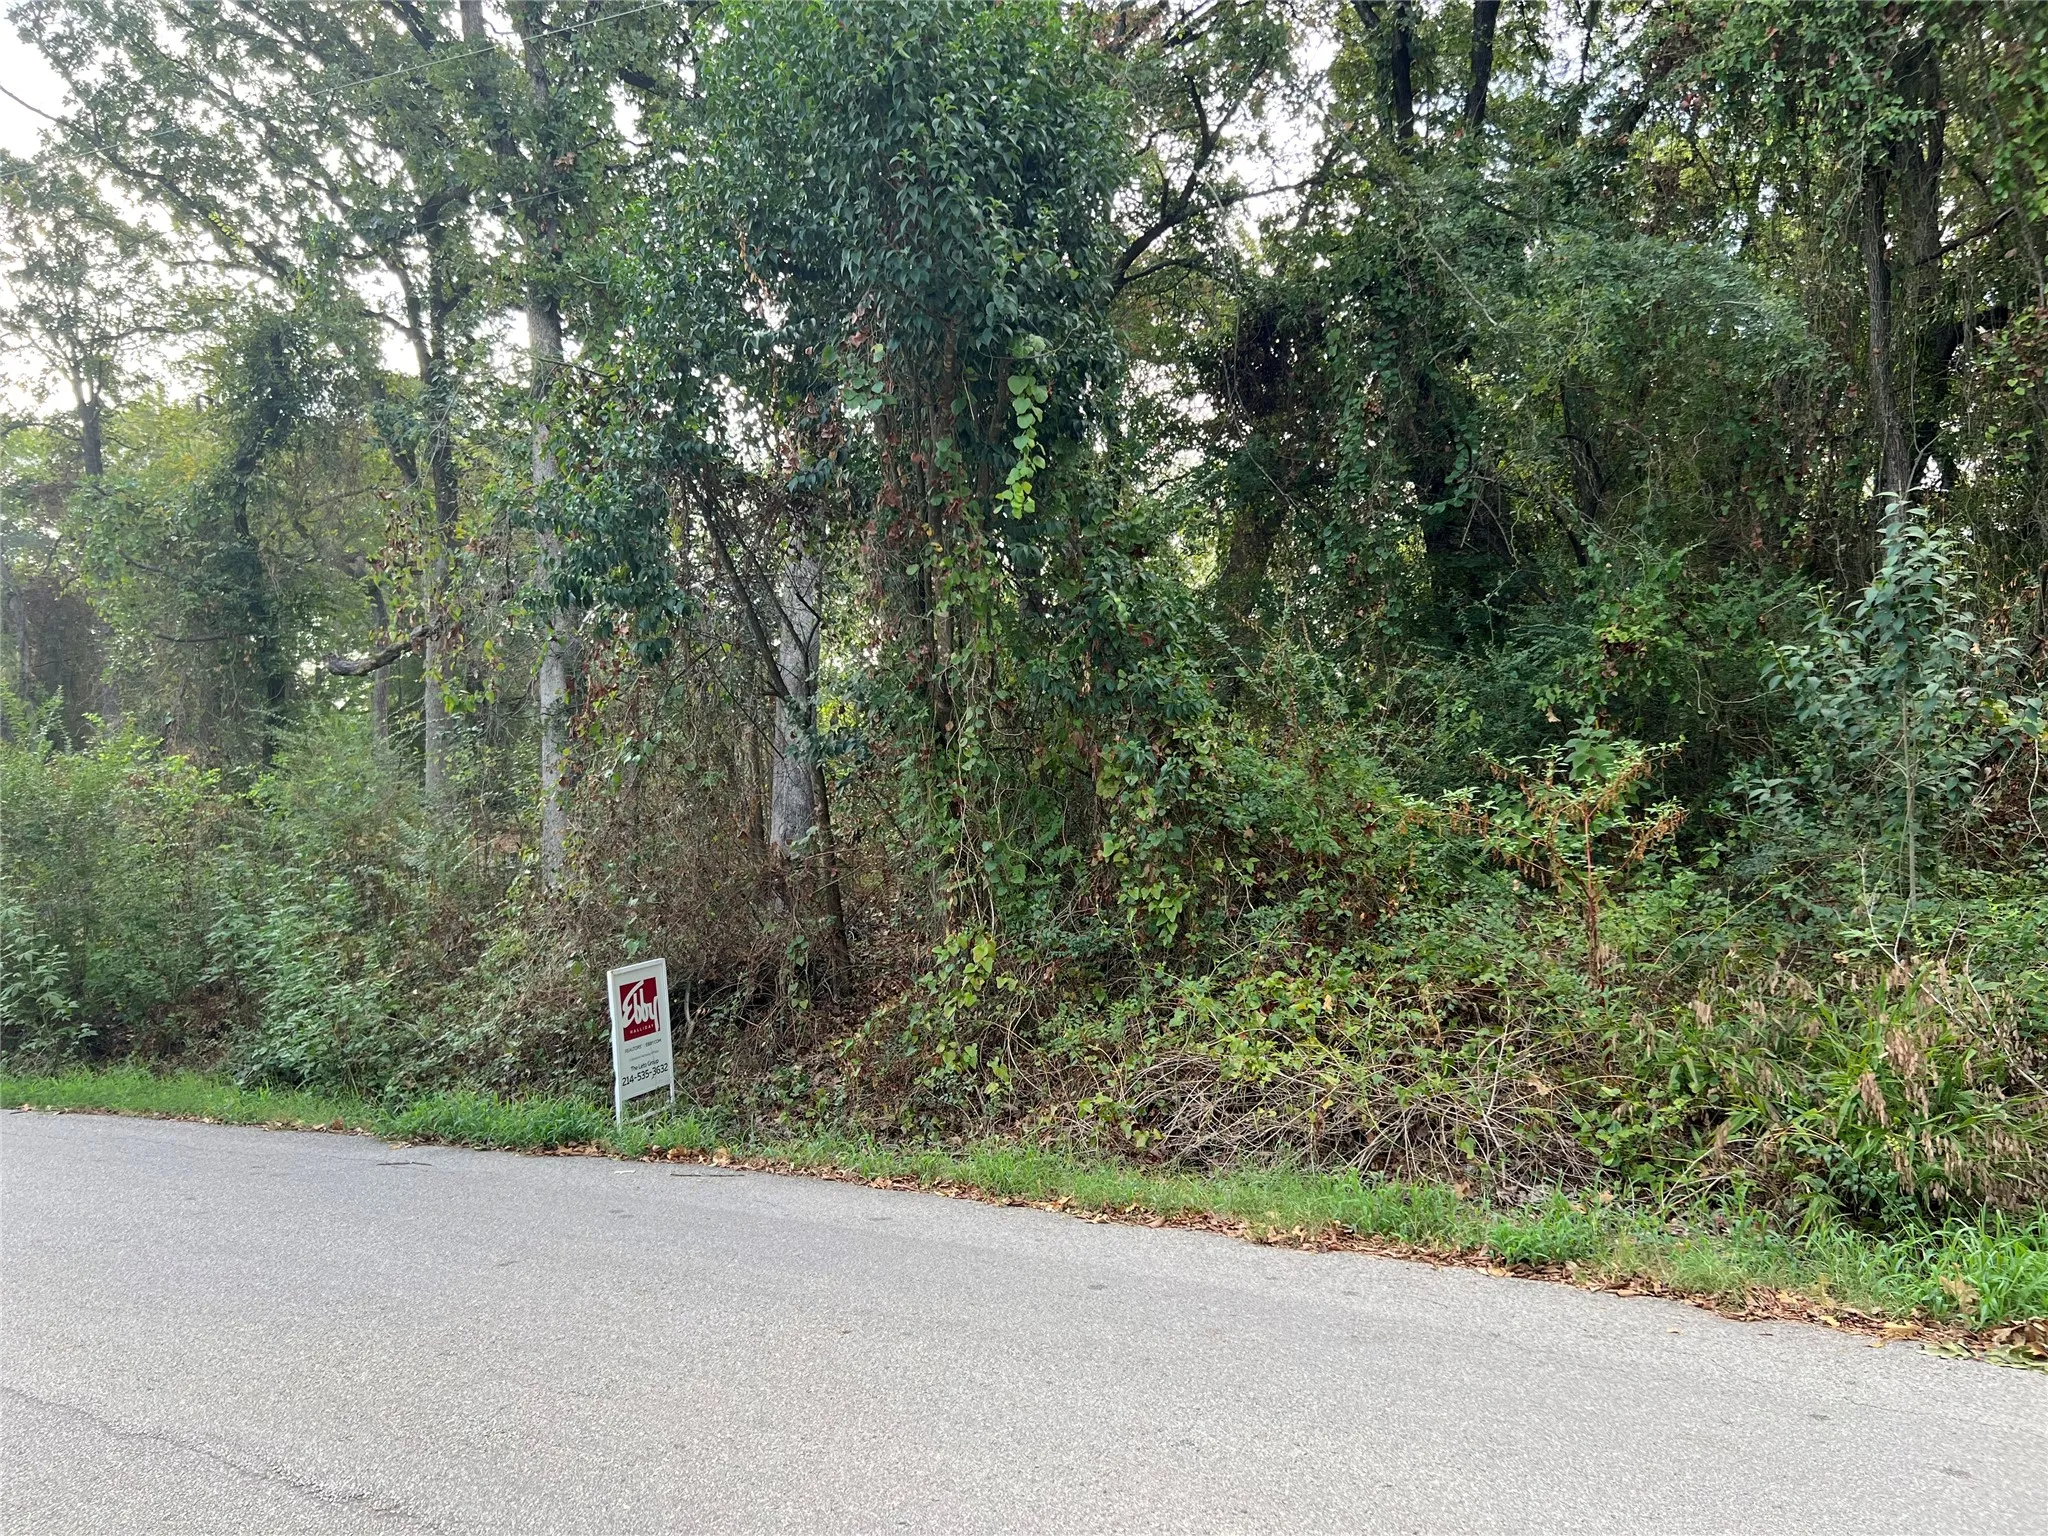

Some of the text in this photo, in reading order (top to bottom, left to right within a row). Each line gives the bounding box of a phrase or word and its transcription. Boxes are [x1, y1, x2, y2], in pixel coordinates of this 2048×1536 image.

[620, 979, 661, 1032] Ebby
[629, 1024, 655, 1034] HALLIDAY
[647, 1058, 660, 1067] Group
[621, 1062, 669, 1087] 214-535-3632
